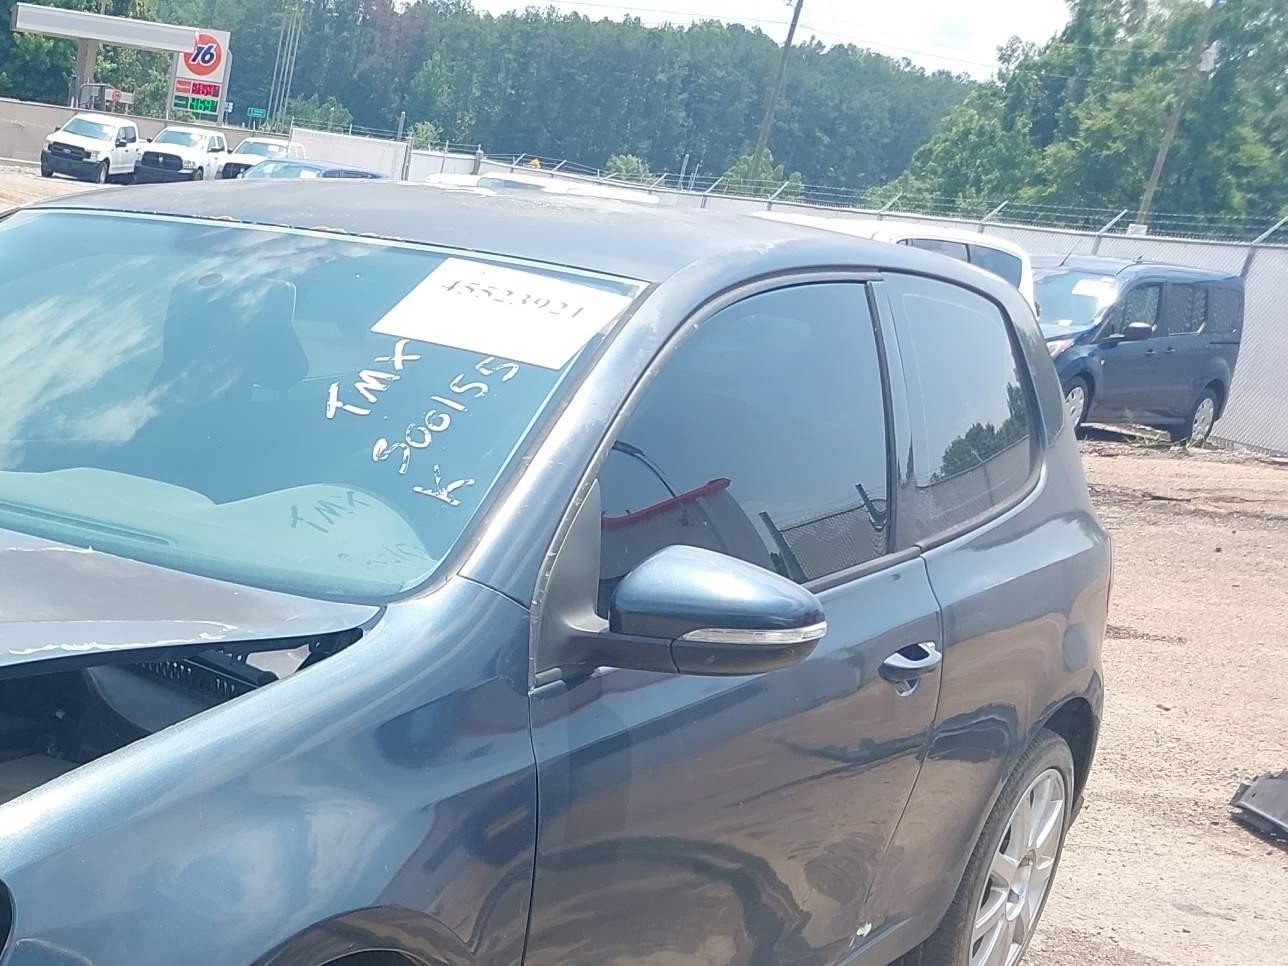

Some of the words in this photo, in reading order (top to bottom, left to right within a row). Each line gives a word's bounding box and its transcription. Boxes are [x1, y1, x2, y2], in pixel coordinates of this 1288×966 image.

[189, 43, 217, 66] 76
[441, 279, 584, 319] 45523921
[325, 339, 420, 419] TMX
